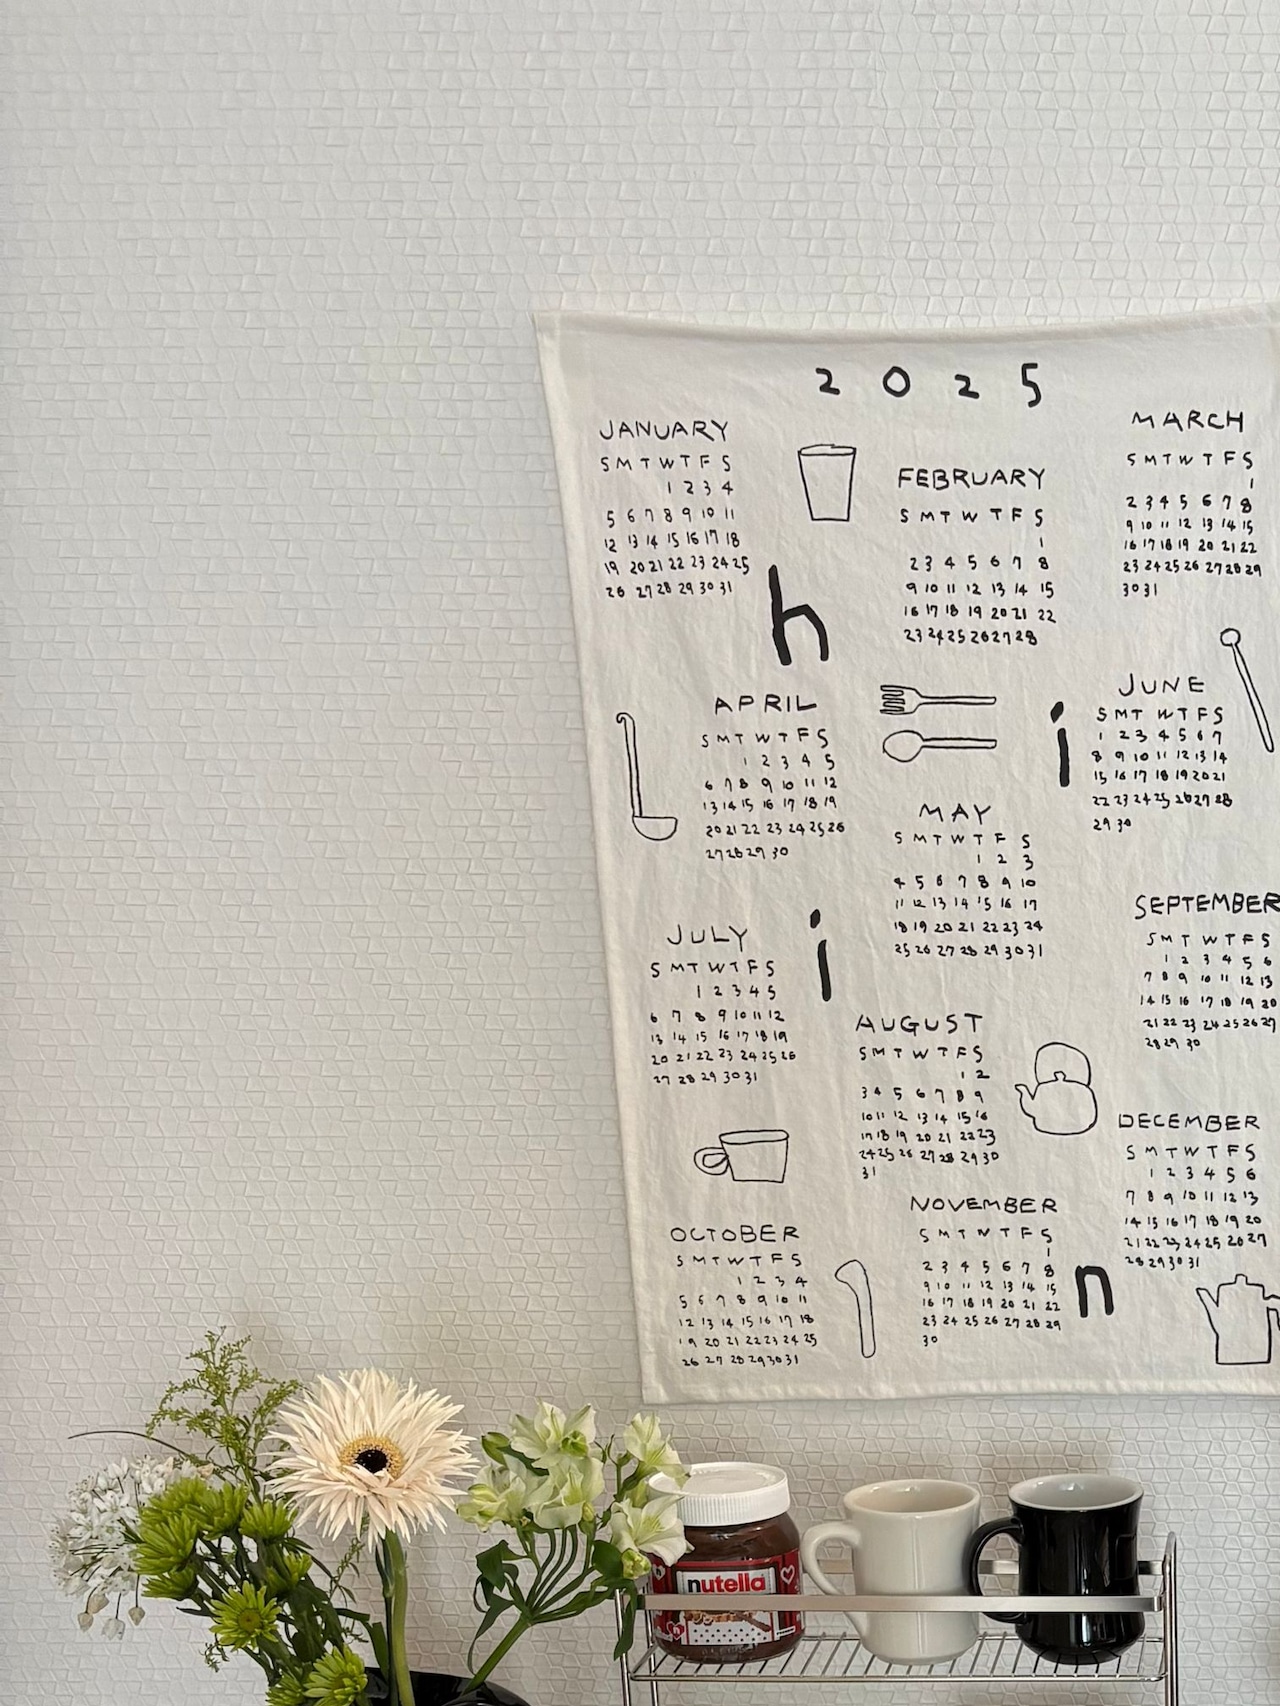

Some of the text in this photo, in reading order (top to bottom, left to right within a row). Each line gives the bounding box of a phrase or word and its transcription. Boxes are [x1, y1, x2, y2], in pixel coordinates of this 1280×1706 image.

[599, 419, 729, 443] JANUARY
[1131, 409, 1244, 434] MARCH
[897, 467, 1046, 491] FEBRUARY
[604, 528, 740, 554] 12 13 14 15 16 17 18
[1123, 537, 1258, 554] 16 17 18 19 20 21 22
[767, 563, 830, 667] h
[904, 602, 1057, 624] 16 17 18 19 20 21 22
[1118, 672, 1205, 698] JUNE
[714, 693, 818, 716] APRIL
[1050, 701, 1071, 788] i
[1094, 768, 1226, 786] 15 16 17 18 19 20 21
[702, 795, 837, 816] 13 14 15 16 17 18 19
[918, 802, 992, 826] MAY
[895, 895, 1038, 912] 11 12 13 14 15 16 17
[666, 923, 748, 953] JULY
[809, 909, 832, 1003] i
[1139, 993, 1278, 1010] 14 15 16 17 18 19 20
[855, 1012, 984, 1037] AUGUST
[650, 1028, 788, 1046] 13 14 15 16 17 18 19
[861, 1109, 989, 1126] 10 11 12 13 14 15 16
[1118, 1112, 1261, 1133] DECEMBER
[910, 1195, 1058, 1215] NOVEMBER
[1124, 1213, 1262, 1231] 14 15 16 17 18 19 20
[670, 1223, 800, 1244] OCTOBER
[921, 1259, 1055, 1278] 2 3 4 5 6 7 8
[1074, 1264, 1115, 1319] n
[922, 1296, 1061, 1312] 16 17 18 19 20 21 22
[678, 1313, 815, 1331] 12 13 14 15 16 17 18
[687, 1572, 766, 1594] nutella
